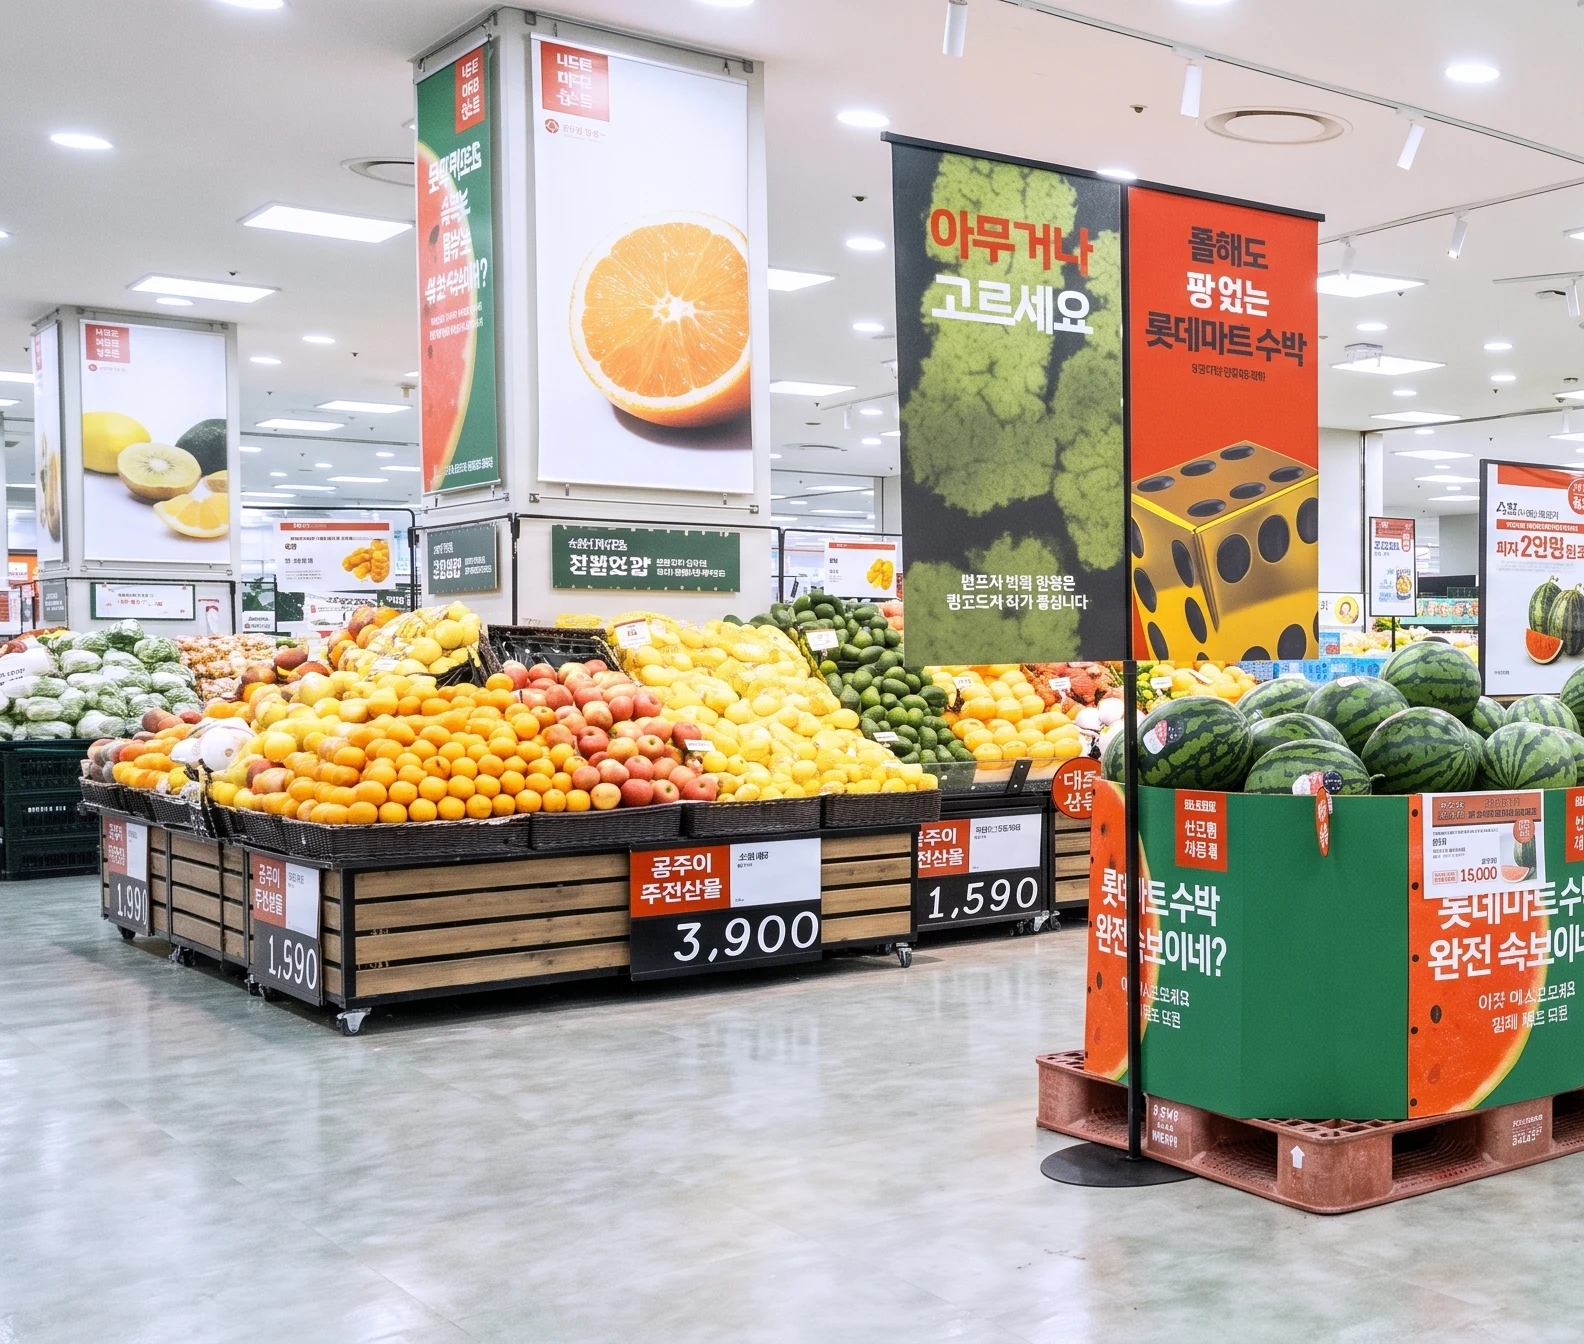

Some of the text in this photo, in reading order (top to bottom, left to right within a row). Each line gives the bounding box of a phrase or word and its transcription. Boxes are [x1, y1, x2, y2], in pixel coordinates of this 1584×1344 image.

[930, 208, 1094, 277] 아무거나
[931, 274, 1094, 335] 고르세요
[1145, 310, 1308, 367] 롯데마트 수박
[928, 877, 1038, 919] 1,590
[1460, 866, 1497, 884] 15,000
[1169, 882, 1221, 927] 수박
[673, 911, 819, 963] 3,900
[1427, 933, 1491, 981] 완전
